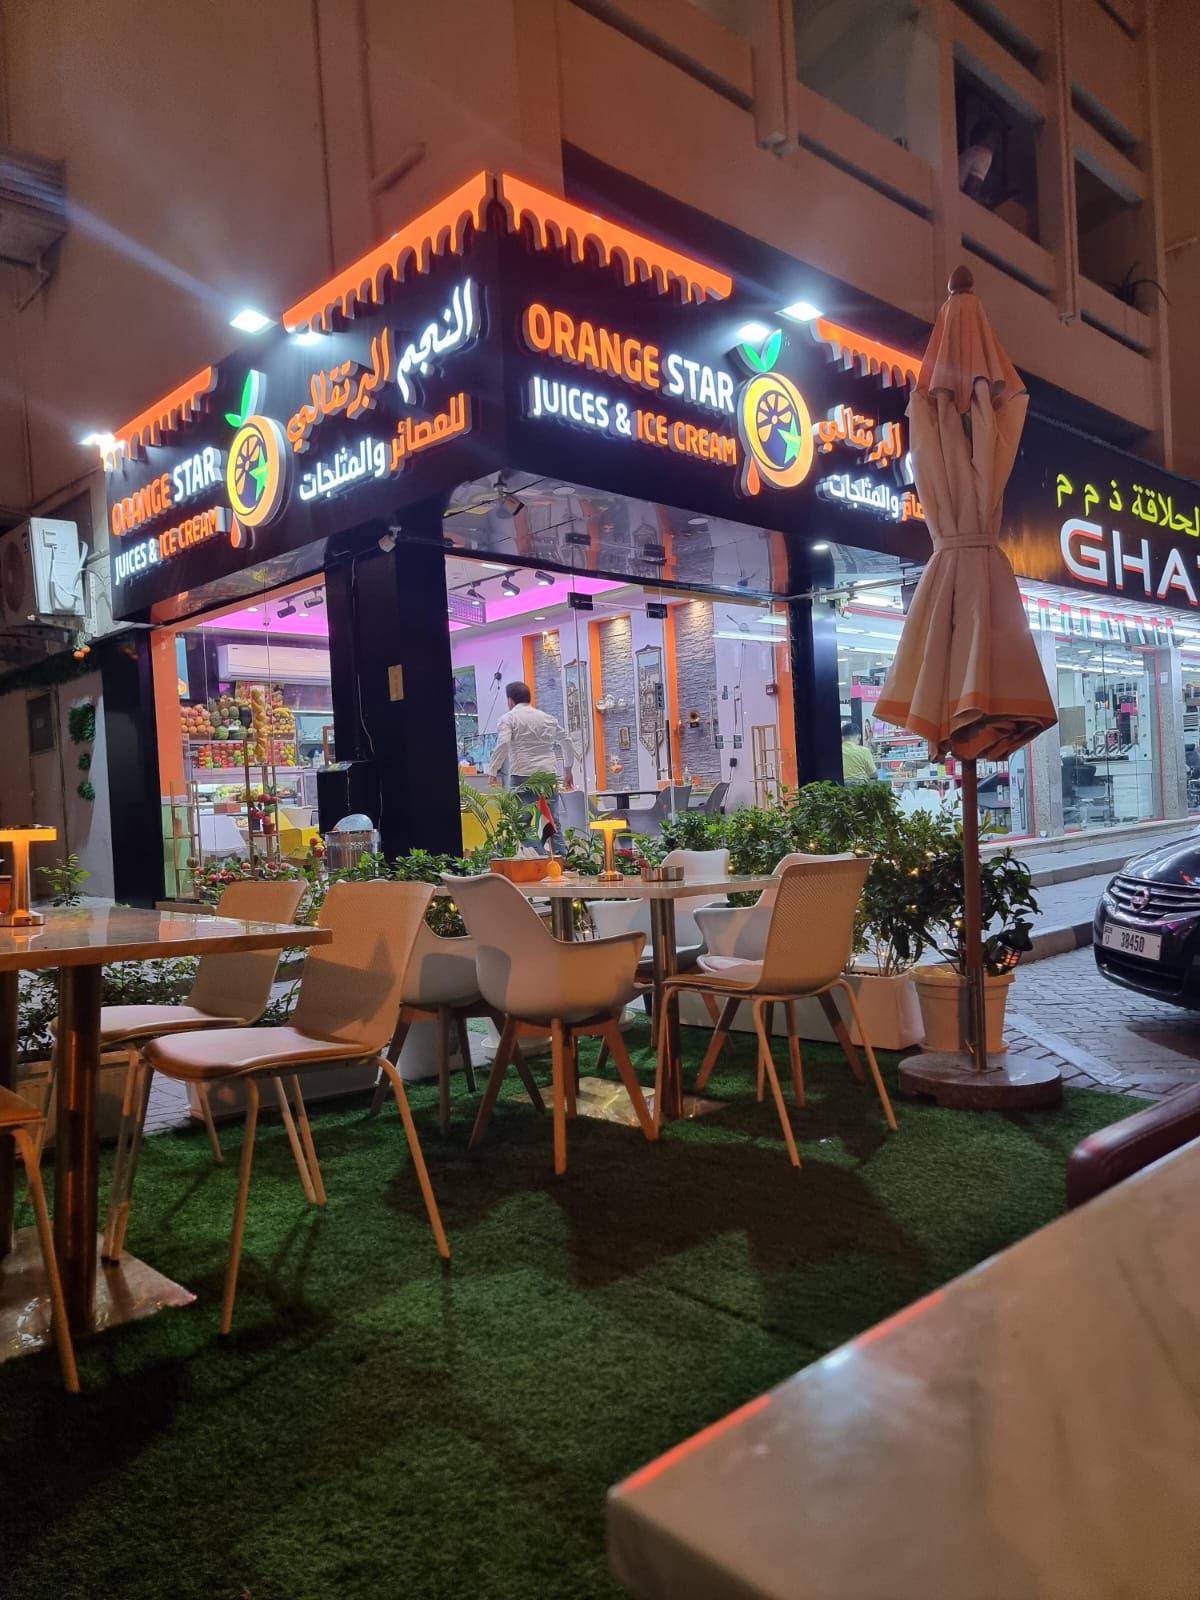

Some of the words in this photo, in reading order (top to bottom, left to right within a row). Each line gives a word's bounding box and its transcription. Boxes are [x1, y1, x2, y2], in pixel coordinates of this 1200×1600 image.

[397, 278, 473, 403] النجم
[528, 304, 660, 389] ORANGE
[668, 355, 735, 413] STAR
[287, 327, 390, 453] البرتقالي
[533, 376, 609, 428] JUICES
[616, 402, 632, 436] &
[637, 409, 667, 446] ICE
[673, 421, 737, 465] CREAM
[299, 436, 385, 501] والمثلجات
[390, 392, 464, 471] للعصائر
[819, 404, 900, 467] البرتقالي
[112, 472, 171, 535] ORANGE
[173, 446, 216, 503] STAR
[828, 474, 899, 519] والمثلجات
[1056, 473, 1073, 508] م
[1084, 484, 1100, 516] م
[1109, 480, 1123, 511] ذ
[114, 543, 147, 585] JUICES
[149, 539, 158, 562] &
[159, 523, 177, 559] ICE
[178, 506, 220, 547] CREAM
[1060, 518, 1200, 605] GHA
[1120, 932, 1145, 953] 38450
